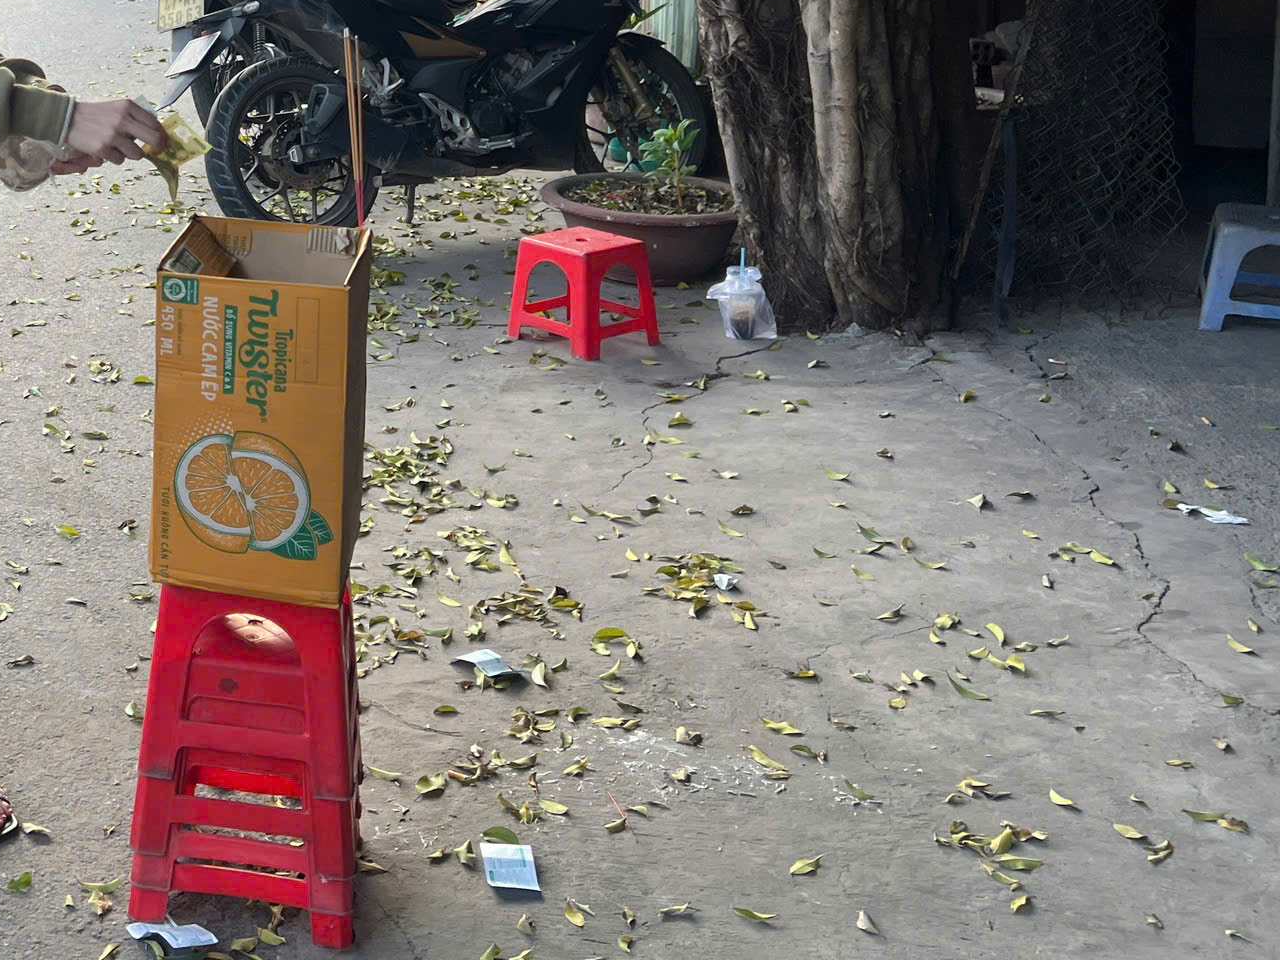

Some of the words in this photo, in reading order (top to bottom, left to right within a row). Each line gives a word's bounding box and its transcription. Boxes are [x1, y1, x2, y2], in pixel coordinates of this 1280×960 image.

[160, 305, 177, 331] 450
[202, 296, 222, 340] NƯỚC
[225, 321, 233, 340] SUNG
[160, 337, 174, 356] ML
[200, 342, 217, 378] CAM
[224, 342, 233, 370] VITAMIN
[239, 289, 279, 417] Twister
[272, 329, 294, 392] Tropicana
[200, 380, 220, 402] ÉP
